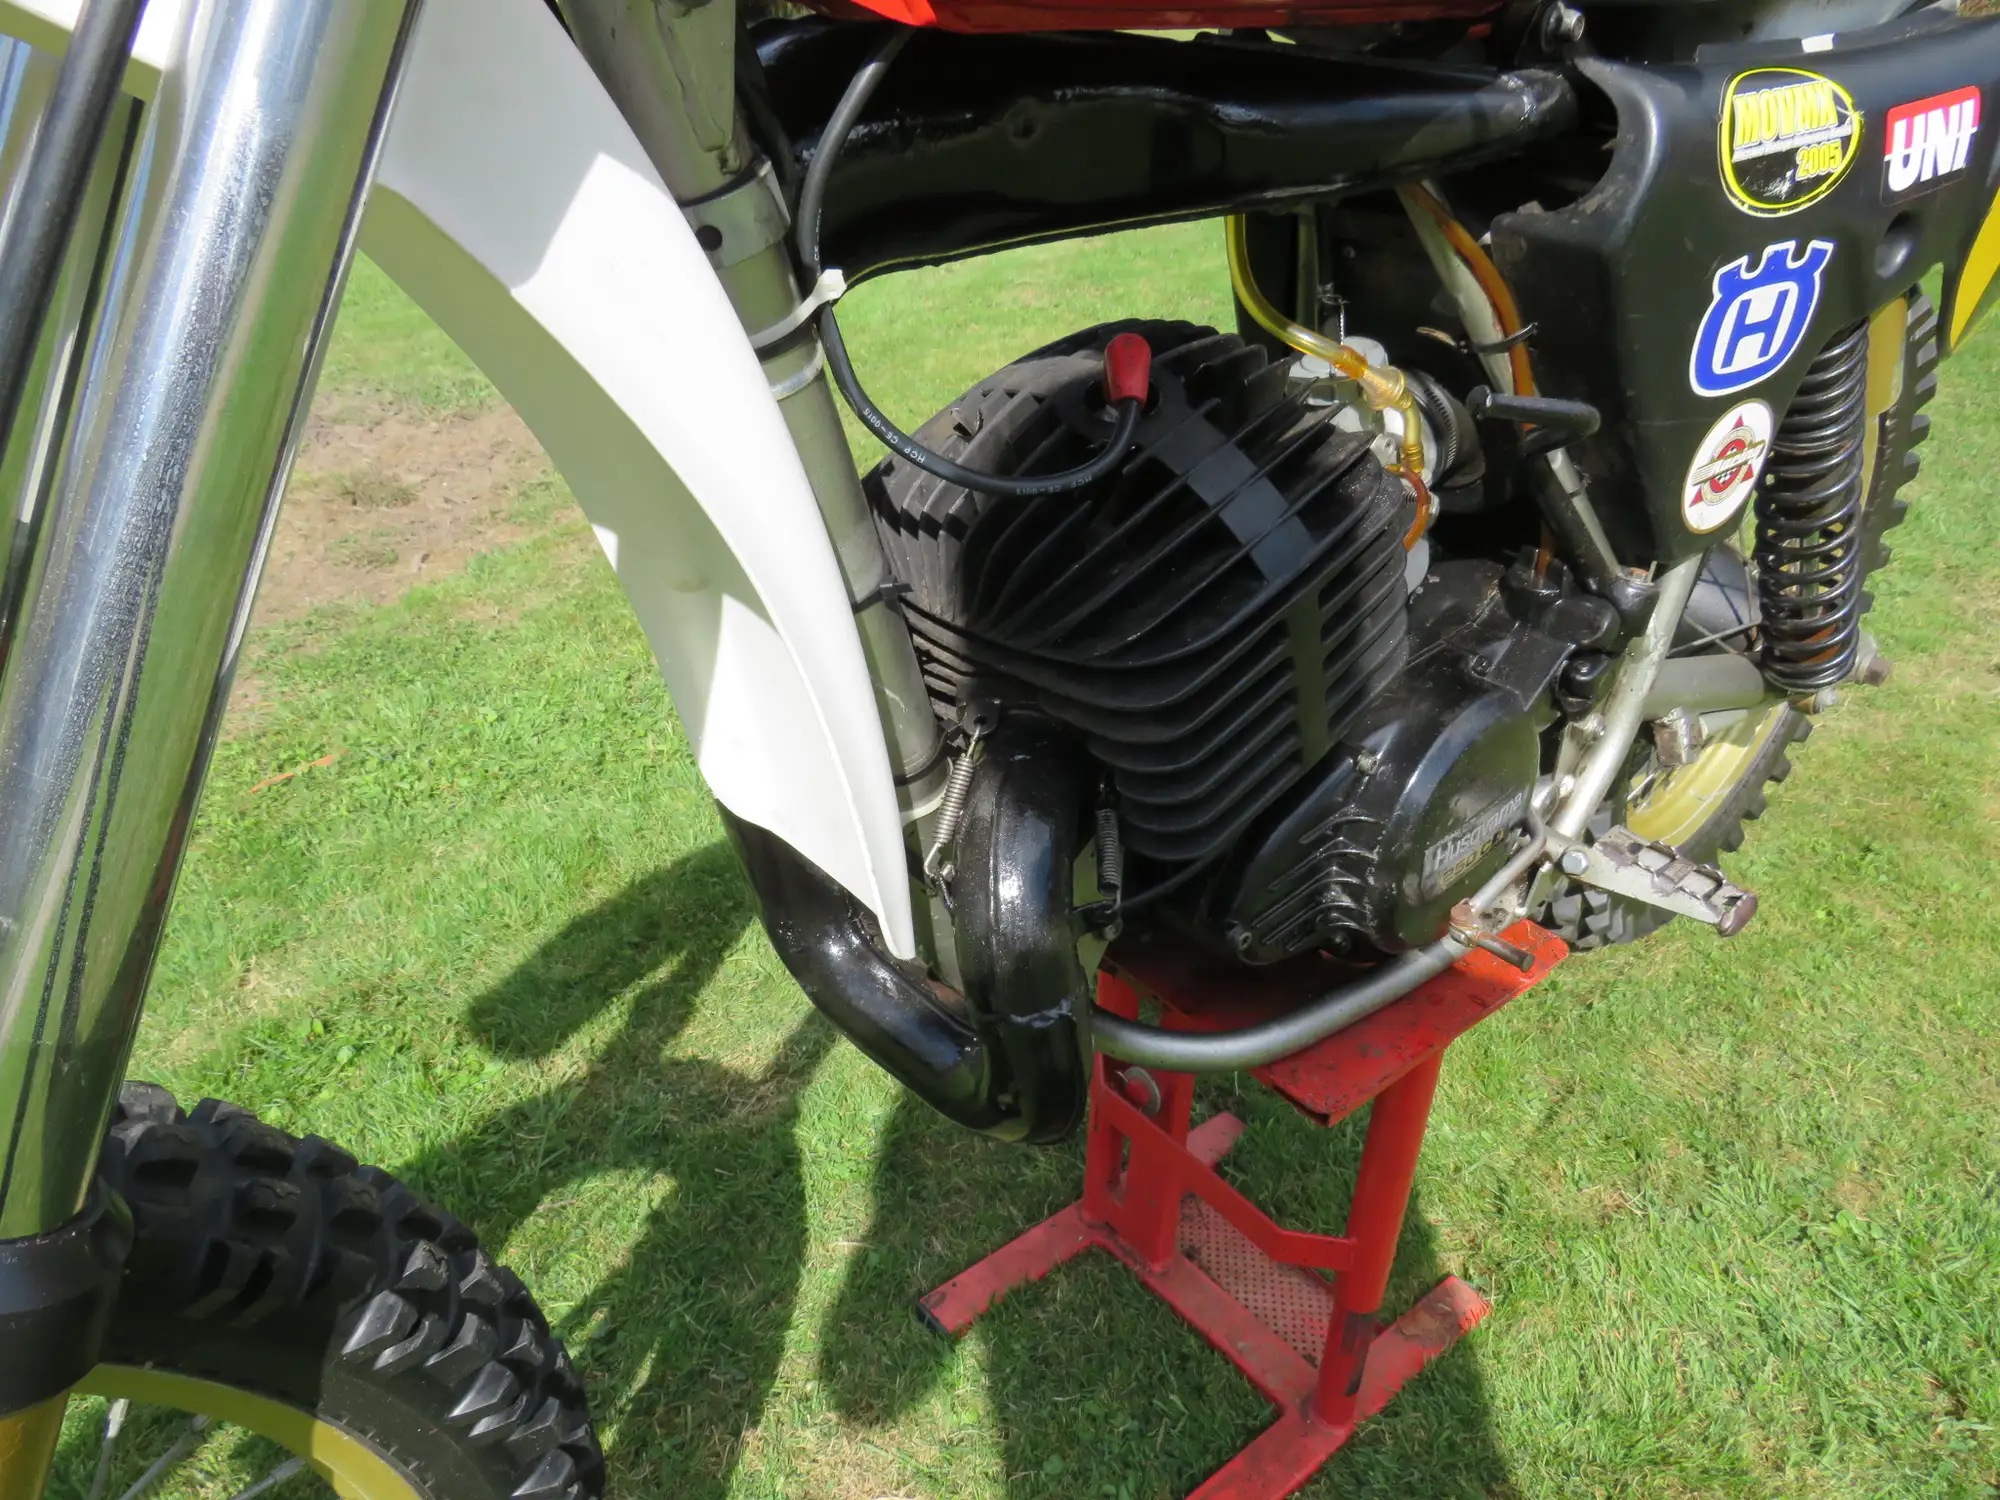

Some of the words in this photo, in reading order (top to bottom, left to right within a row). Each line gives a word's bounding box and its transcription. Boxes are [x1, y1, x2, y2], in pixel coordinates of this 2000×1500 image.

[1733, 80, 1838, 149] MOVMX
[1886, 98, 1976, 192] UNI
[1796, 140, 1843, 181] 2005
[1720, 288, 1790, 370] H
[903, 446, 926, 464] HCP
